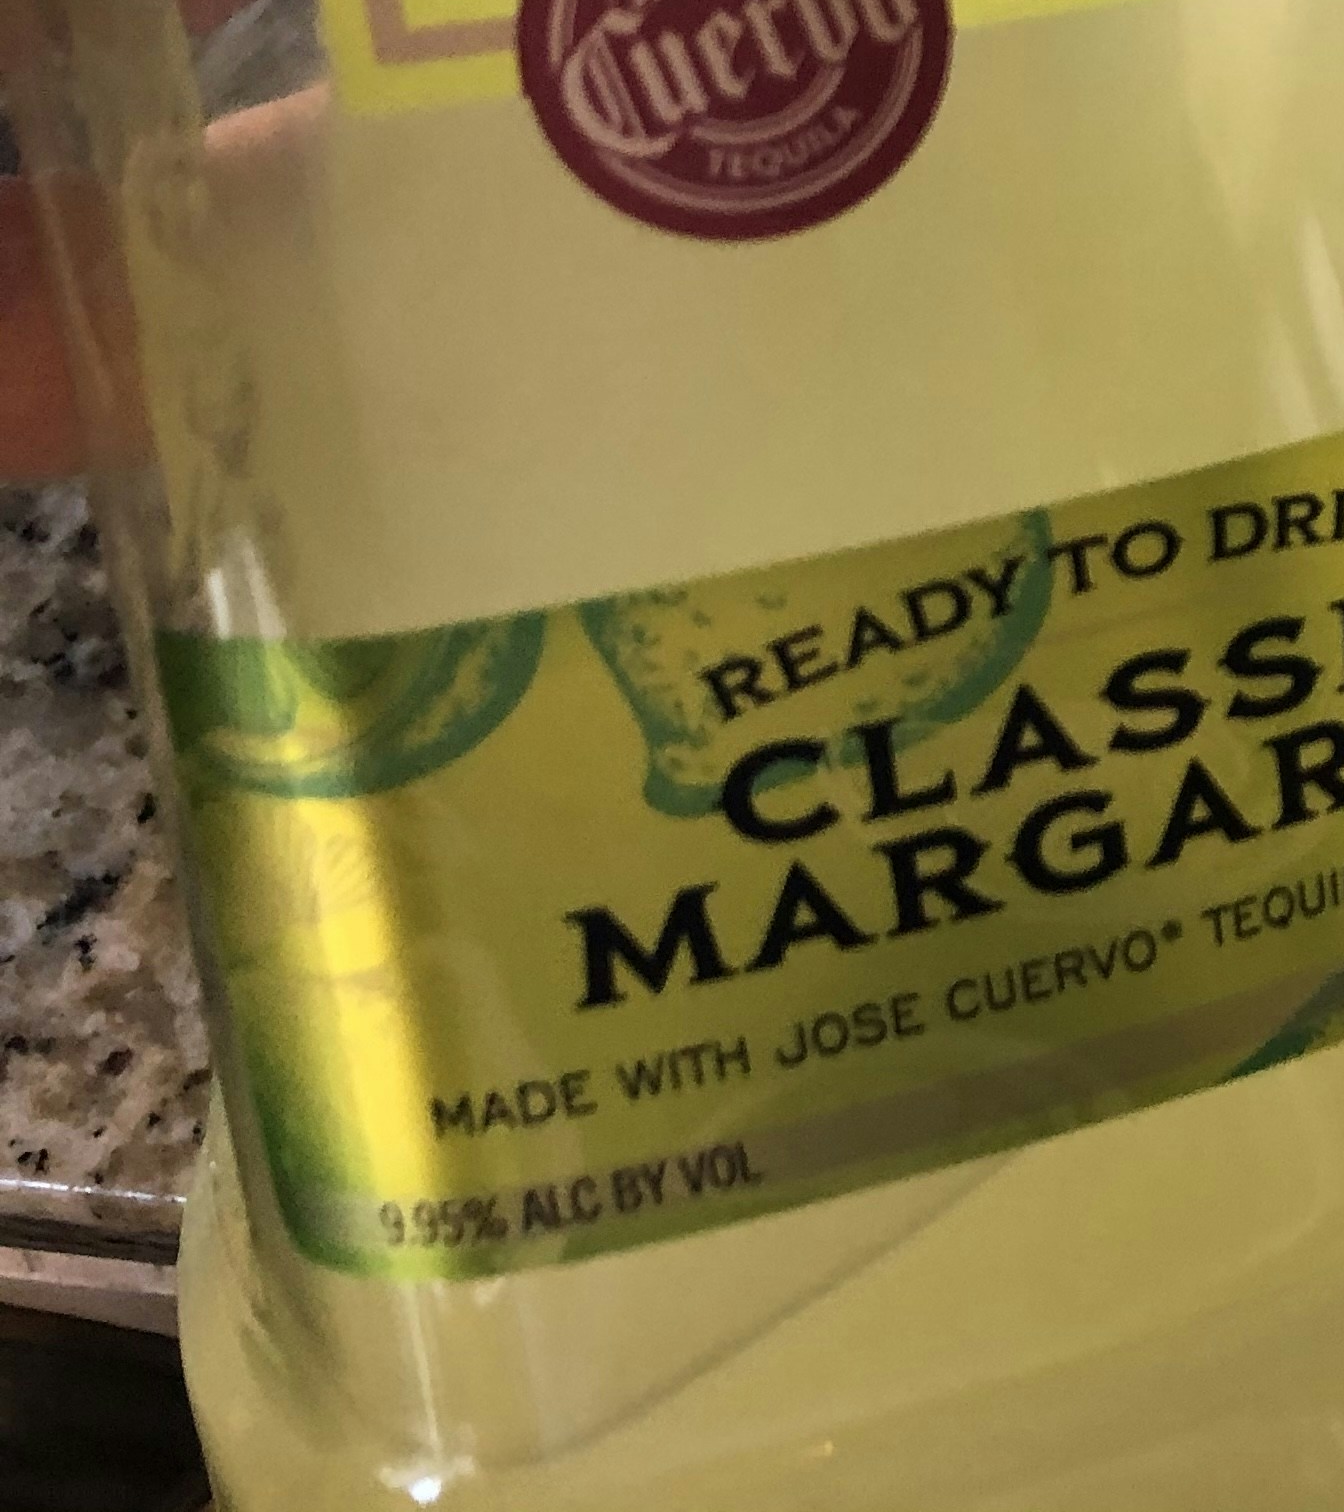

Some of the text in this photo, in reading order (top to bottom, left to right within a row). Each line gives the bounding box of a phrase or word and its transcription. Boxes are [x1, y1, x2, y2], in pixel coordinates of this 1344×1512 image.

[697, 554, 1028, 723] READY
[1050, 519, 1184, 595] TO
[429, 1069, 599, 1141] MADE
[615, 1036, 752, 1101] WITH
[775, 992, 925, 1071] JOSE
[522, 1174, 602, 1235] ALC
[610, 1161, 668, 1215] BY
[677, 1141, 764, 1195] VOL
